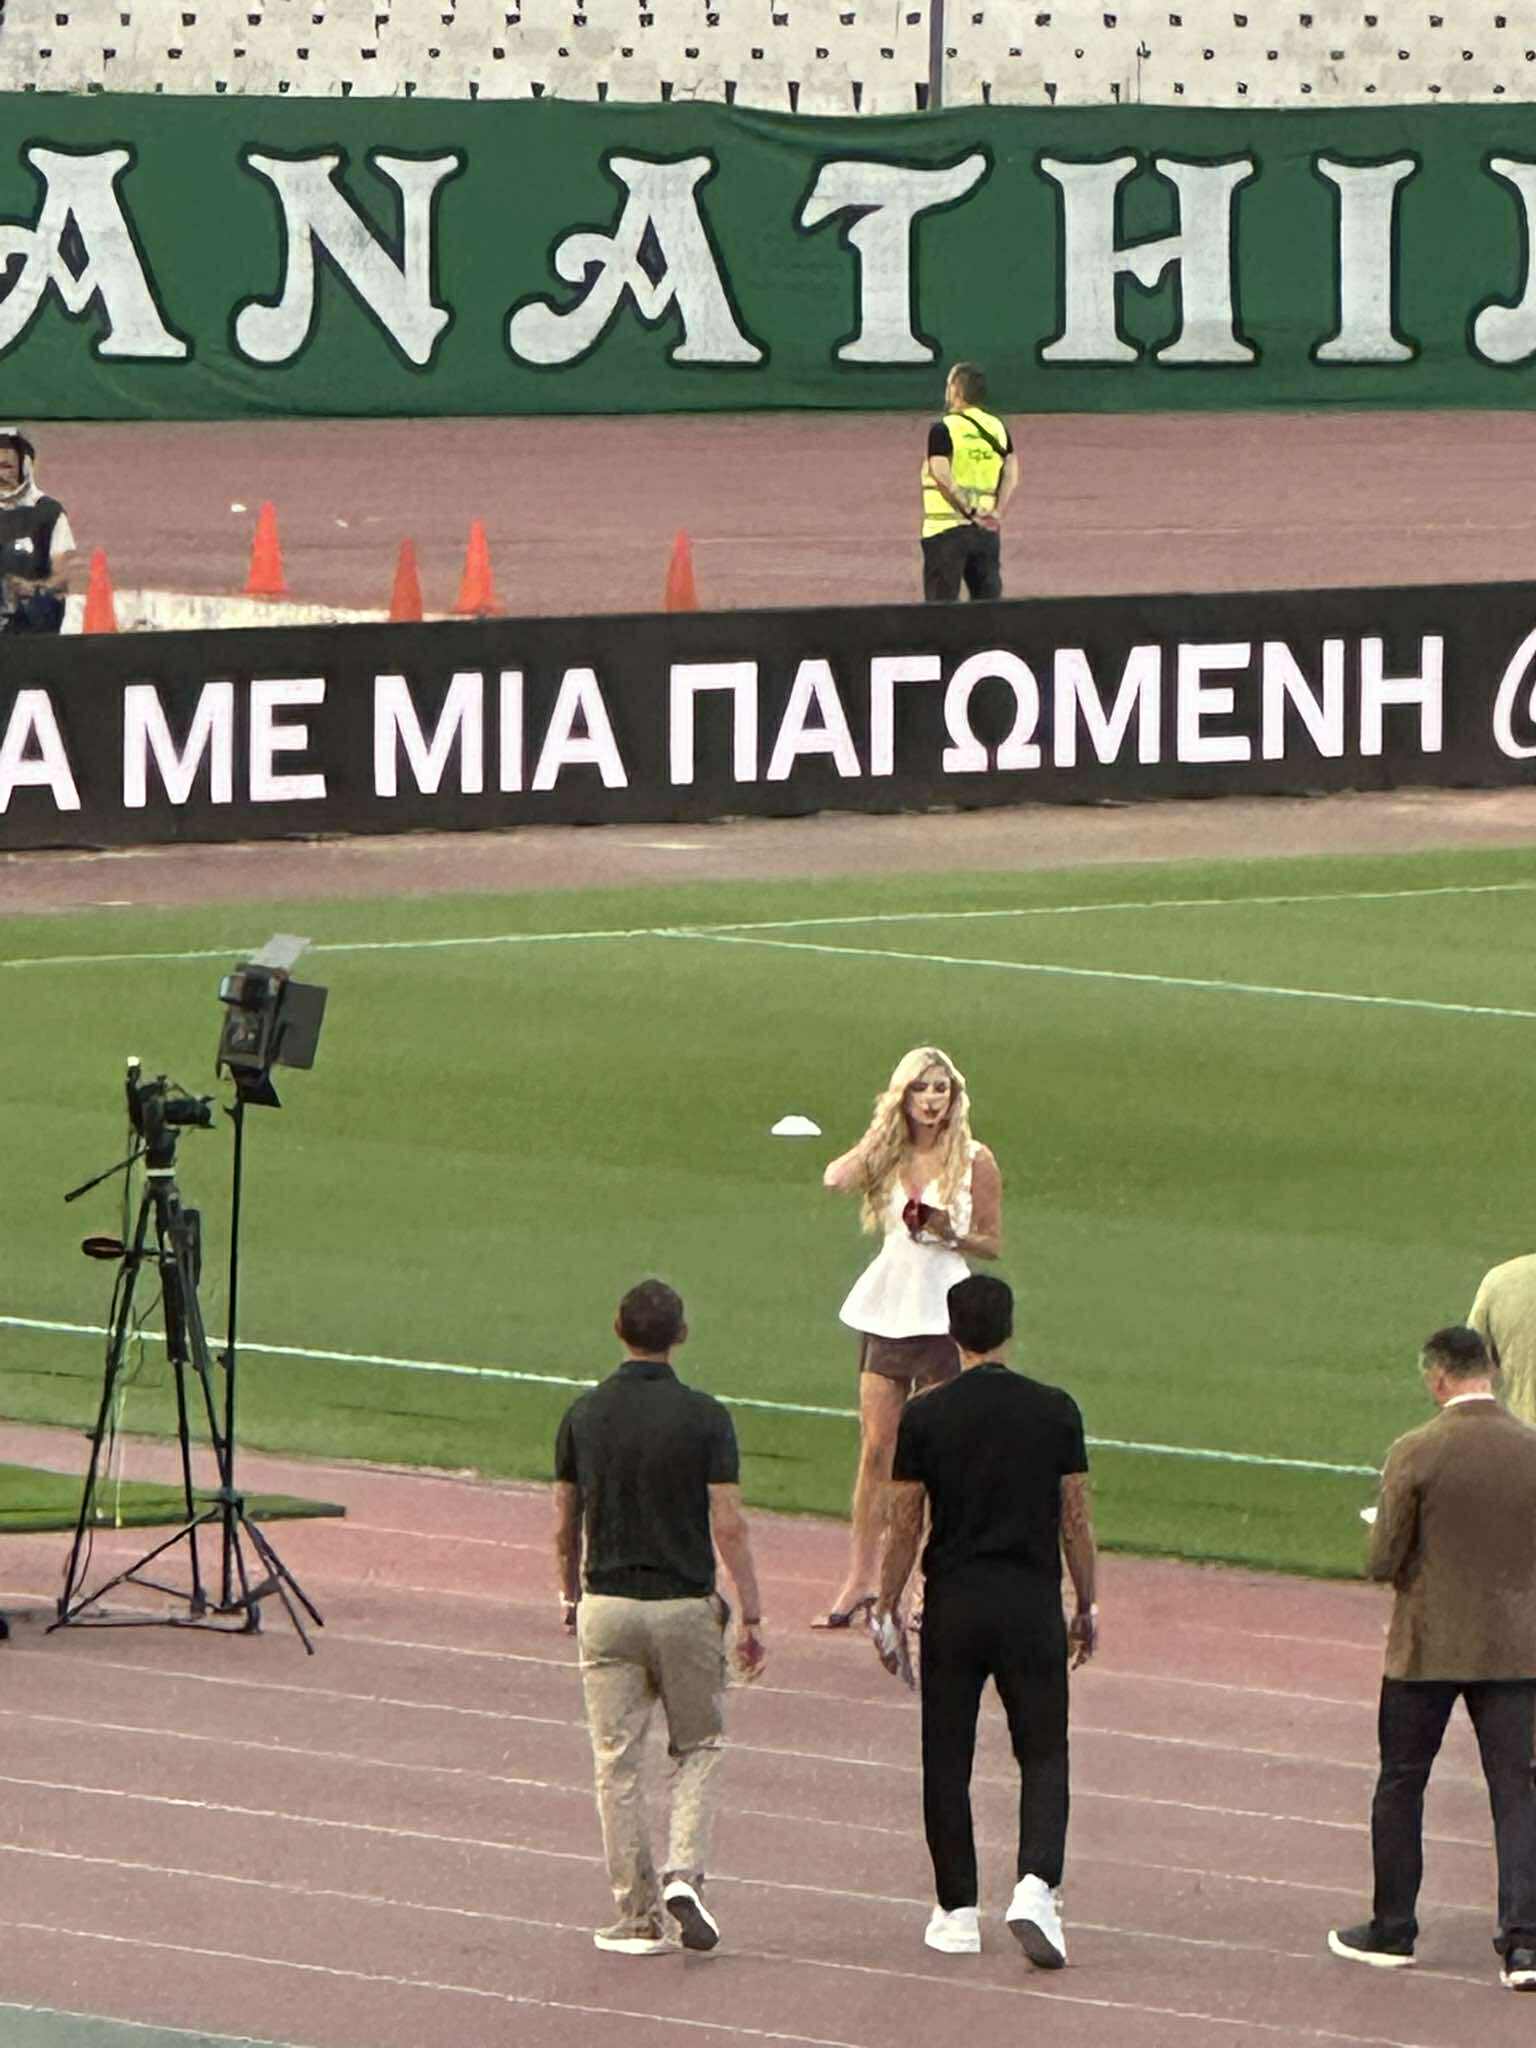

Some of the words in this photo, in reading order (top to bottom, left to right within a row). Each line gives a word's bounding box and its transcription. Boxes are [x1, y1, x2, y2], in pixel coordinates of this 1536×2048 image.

[123, 678, 327, 807] ΜΕ
[374, 668, 628, 797] ΜΙΑ
[669, 636, 1444, 784] ΠΑΓΩΜΕΝΗ
